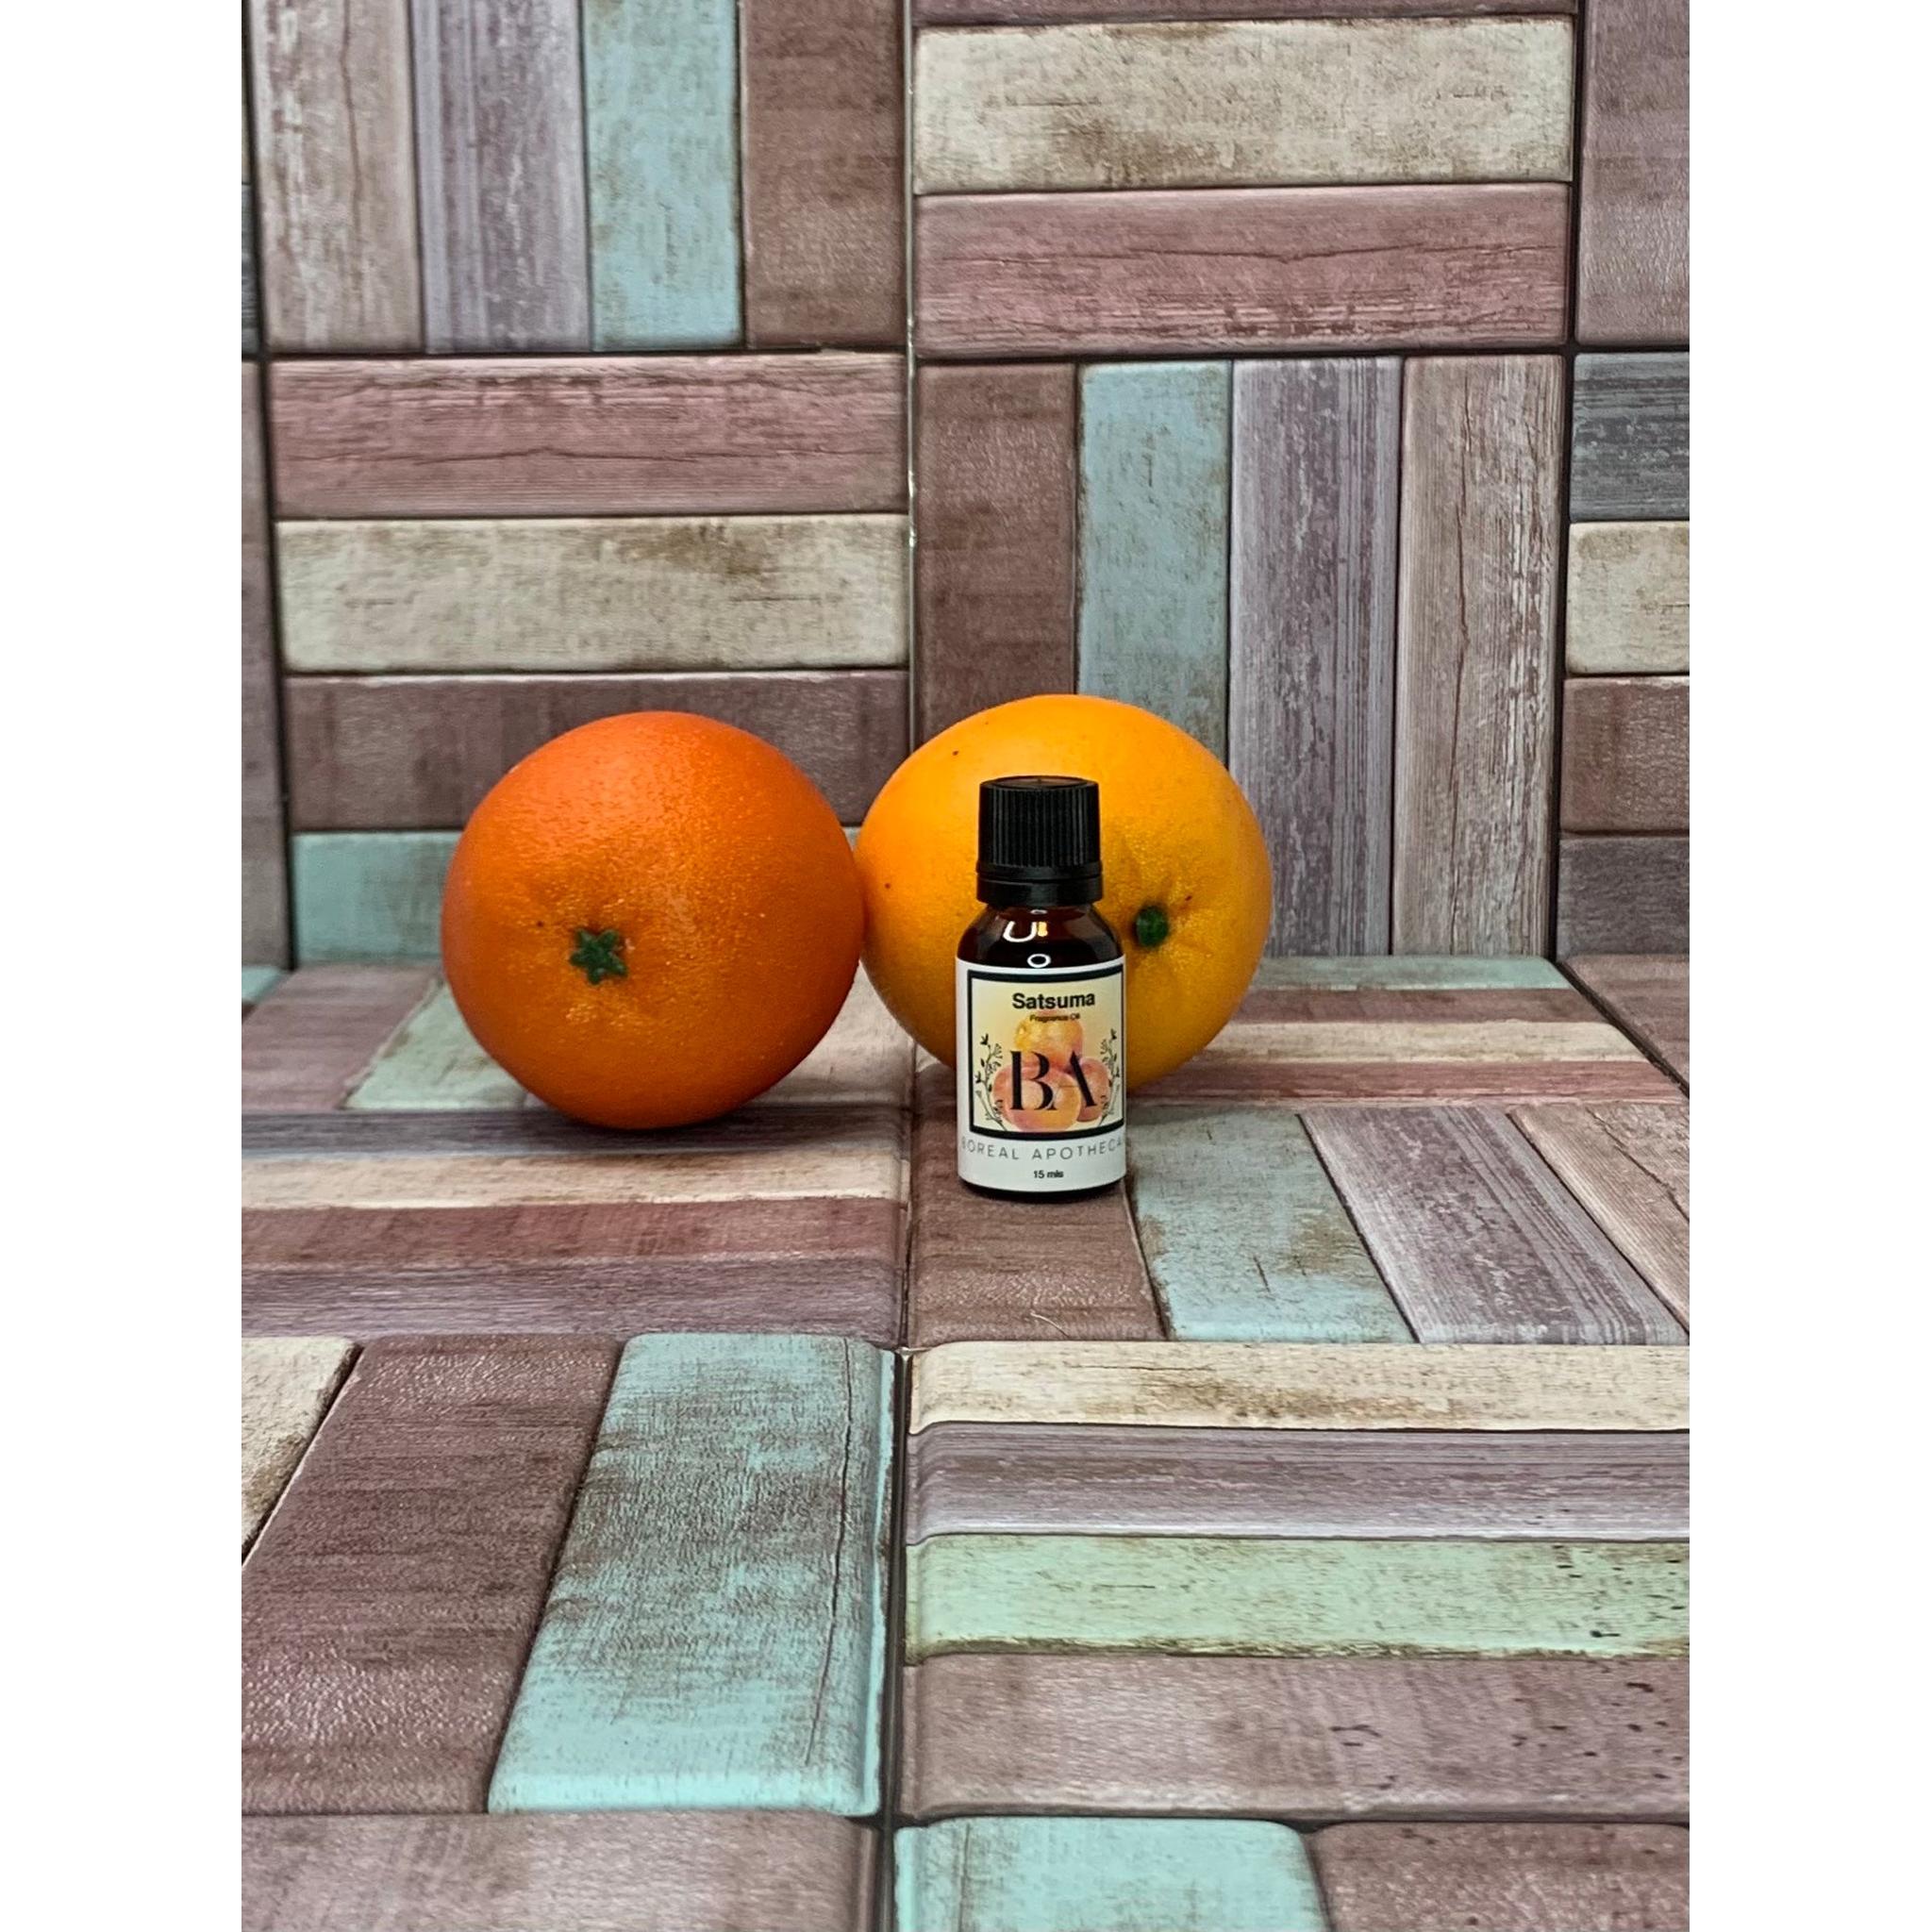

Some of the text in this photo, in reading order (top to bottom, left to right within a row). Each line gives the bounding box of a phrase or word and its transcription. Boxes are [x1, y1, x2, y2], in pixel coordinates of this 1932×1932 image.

[1011, 991, 1095, 1009] Satsuma
[1009, 1050, 1098, 1111] BA
[1033, 1169, 1064, 1179] 15 mls
